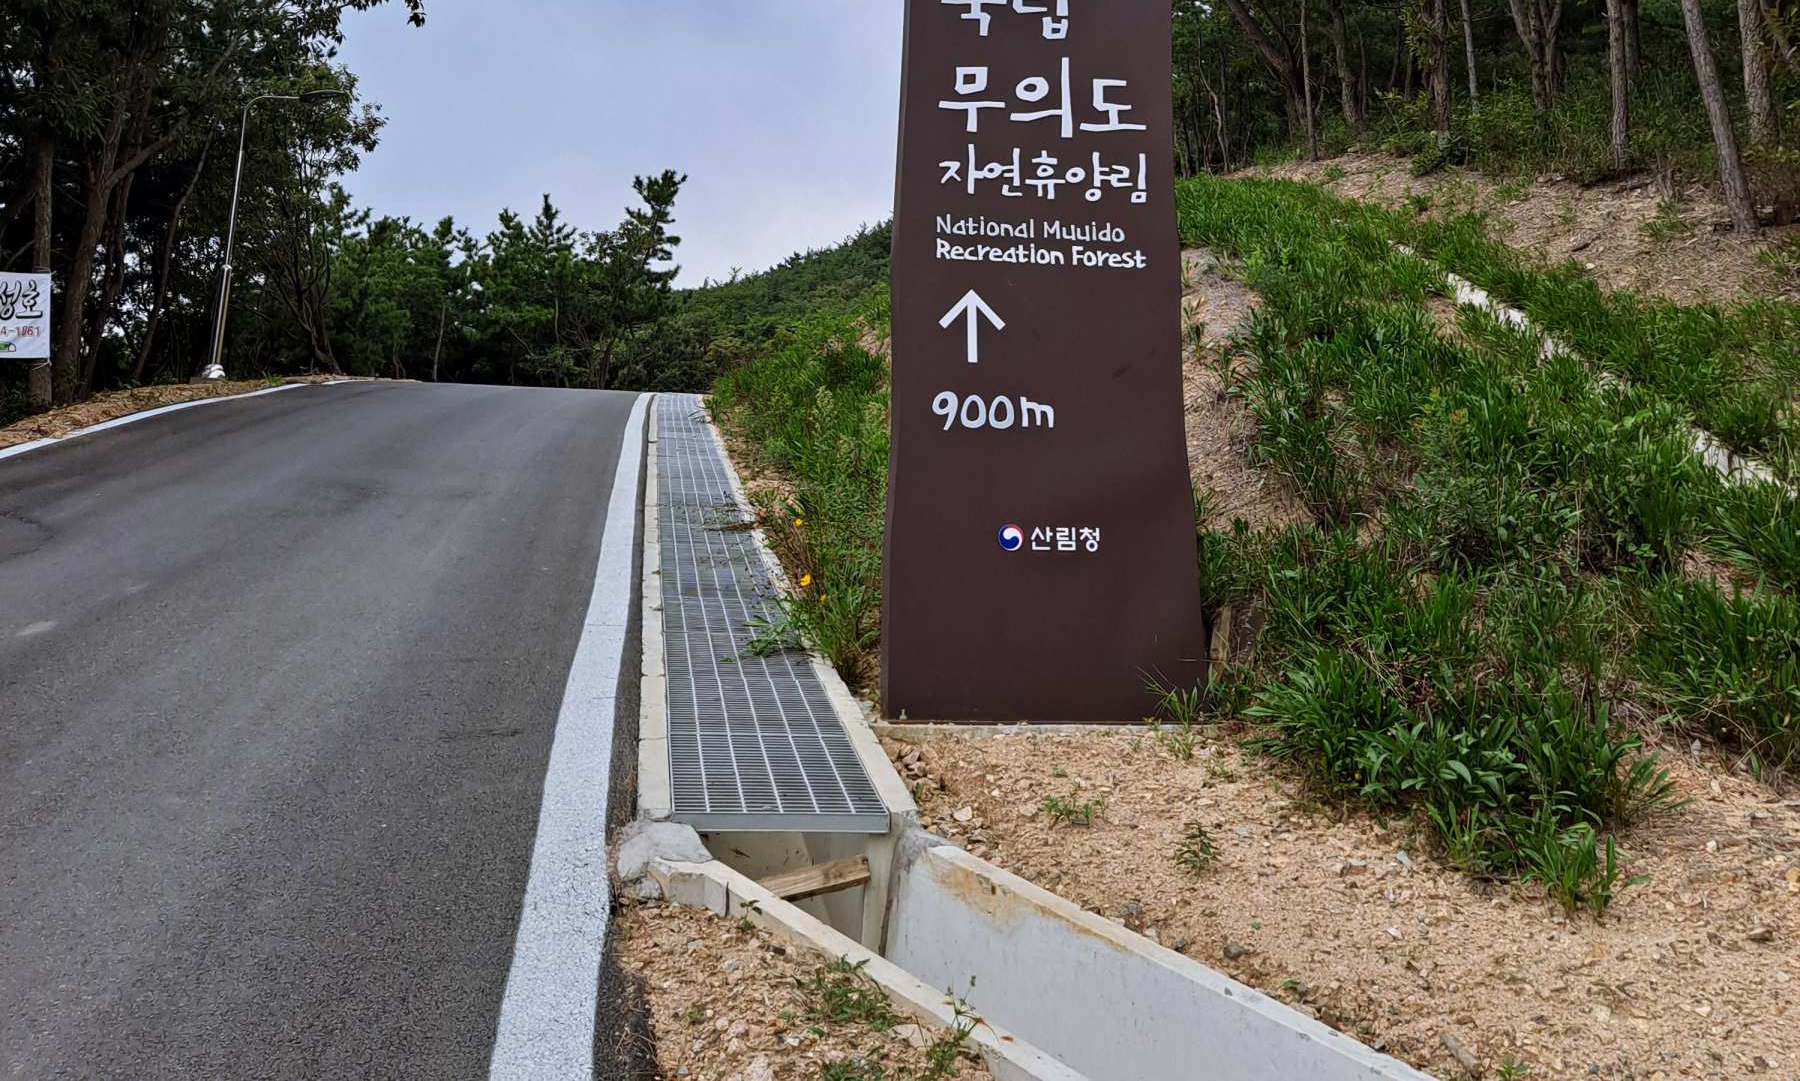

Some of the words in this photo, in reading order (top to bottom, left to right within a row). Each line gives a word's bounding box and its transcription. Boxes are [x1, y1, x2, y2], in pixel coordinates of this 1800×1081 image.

[939, 57, 1146, 137] 무의도
[939, 144, 1146, 203] 자연휴양림
[936, 214, 1035, 239] National
[1043, 220, 1126, 243] Muuido
[936, 238, 1065, 265] Recreation
[1071, 245, 1147, 269] Forest
[932, 391, 1055, 430] 900m
[1030, 526, 1100, 552] 산림청
